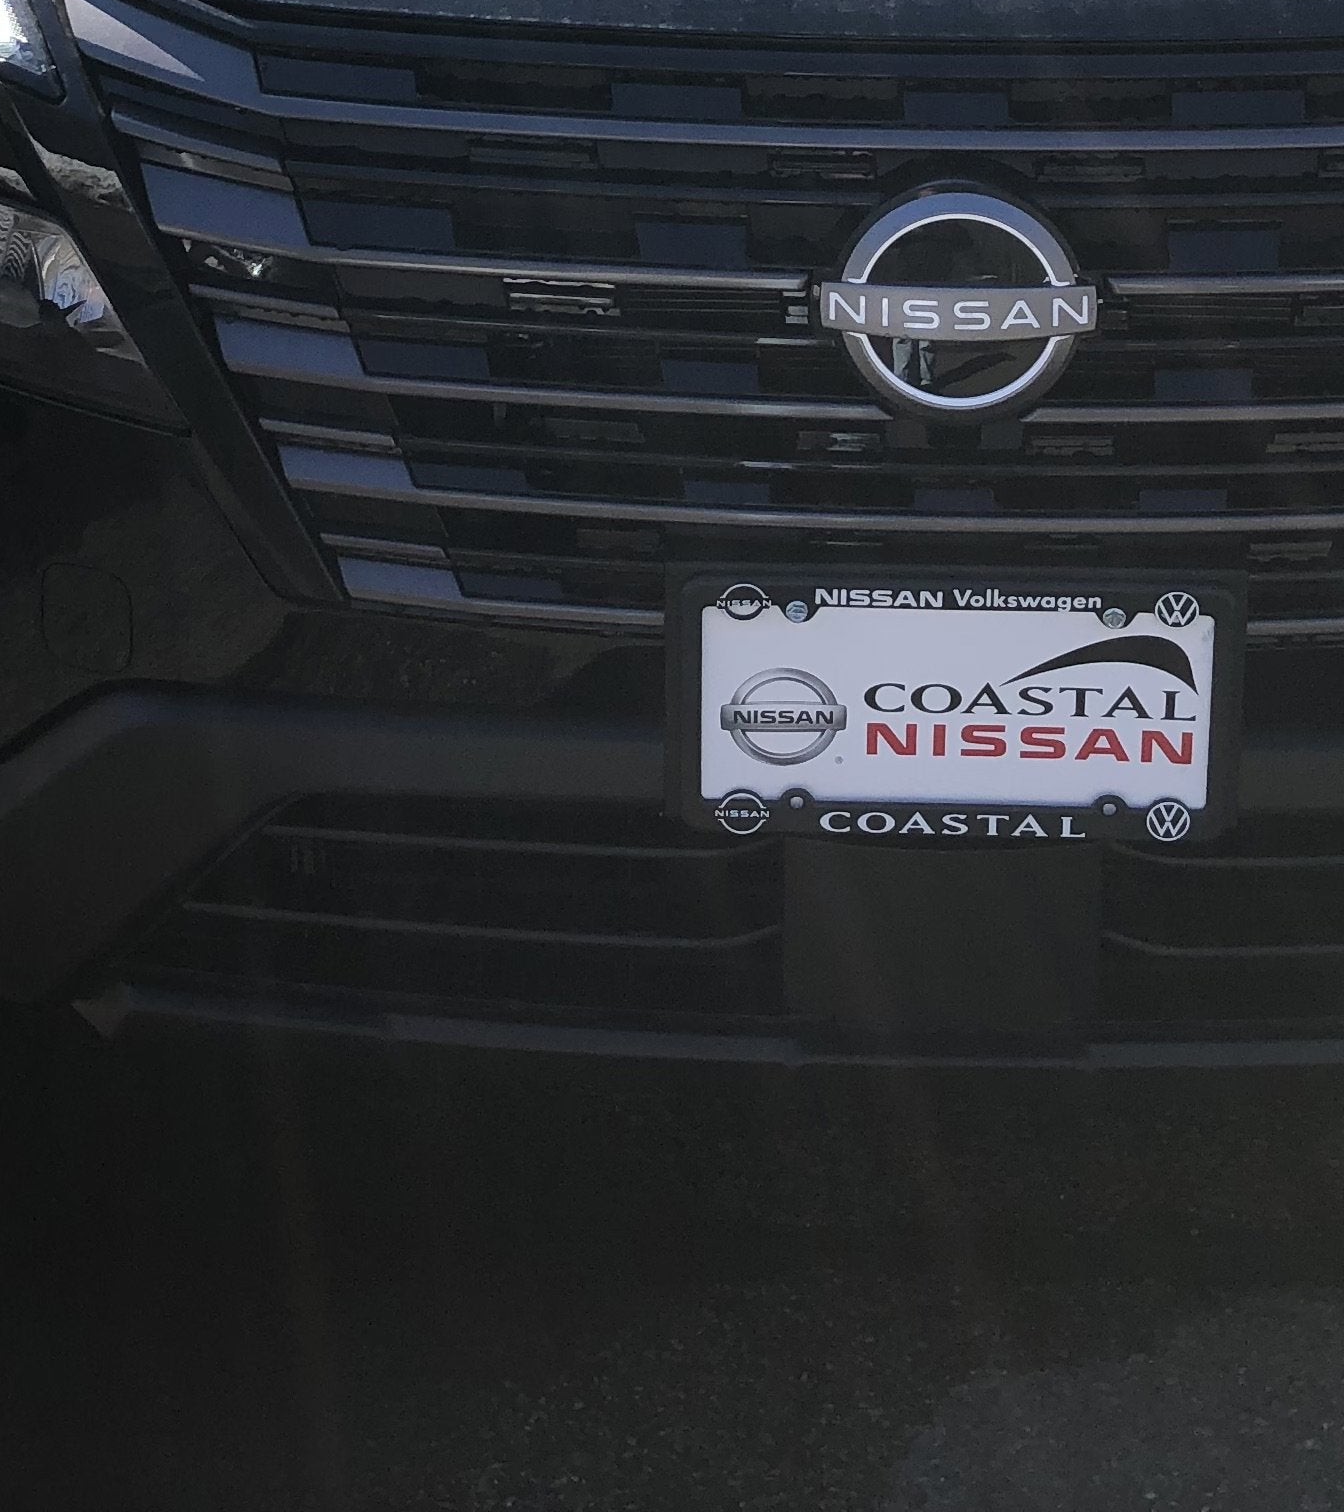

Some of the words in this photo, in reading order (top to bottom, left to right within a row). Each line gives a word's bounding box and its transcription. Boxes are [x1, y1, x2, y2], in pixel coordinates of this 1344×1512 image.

[828, 292, 1088, 330] NISSAN
[716, 598, 772, 609] NISSAN
[814, 588, 944, 608] NISSAN
[953, 588, 1102, 613] Volkswagen
[863, 681, 1197, 722] COASTAL
[733, 709, 834, 726] NISSAN
[866, 722, 1194, 765] NISSAN
[714, 808, 770, 819] NISSAN
[819, 811, 1086, 839] COASTAL
